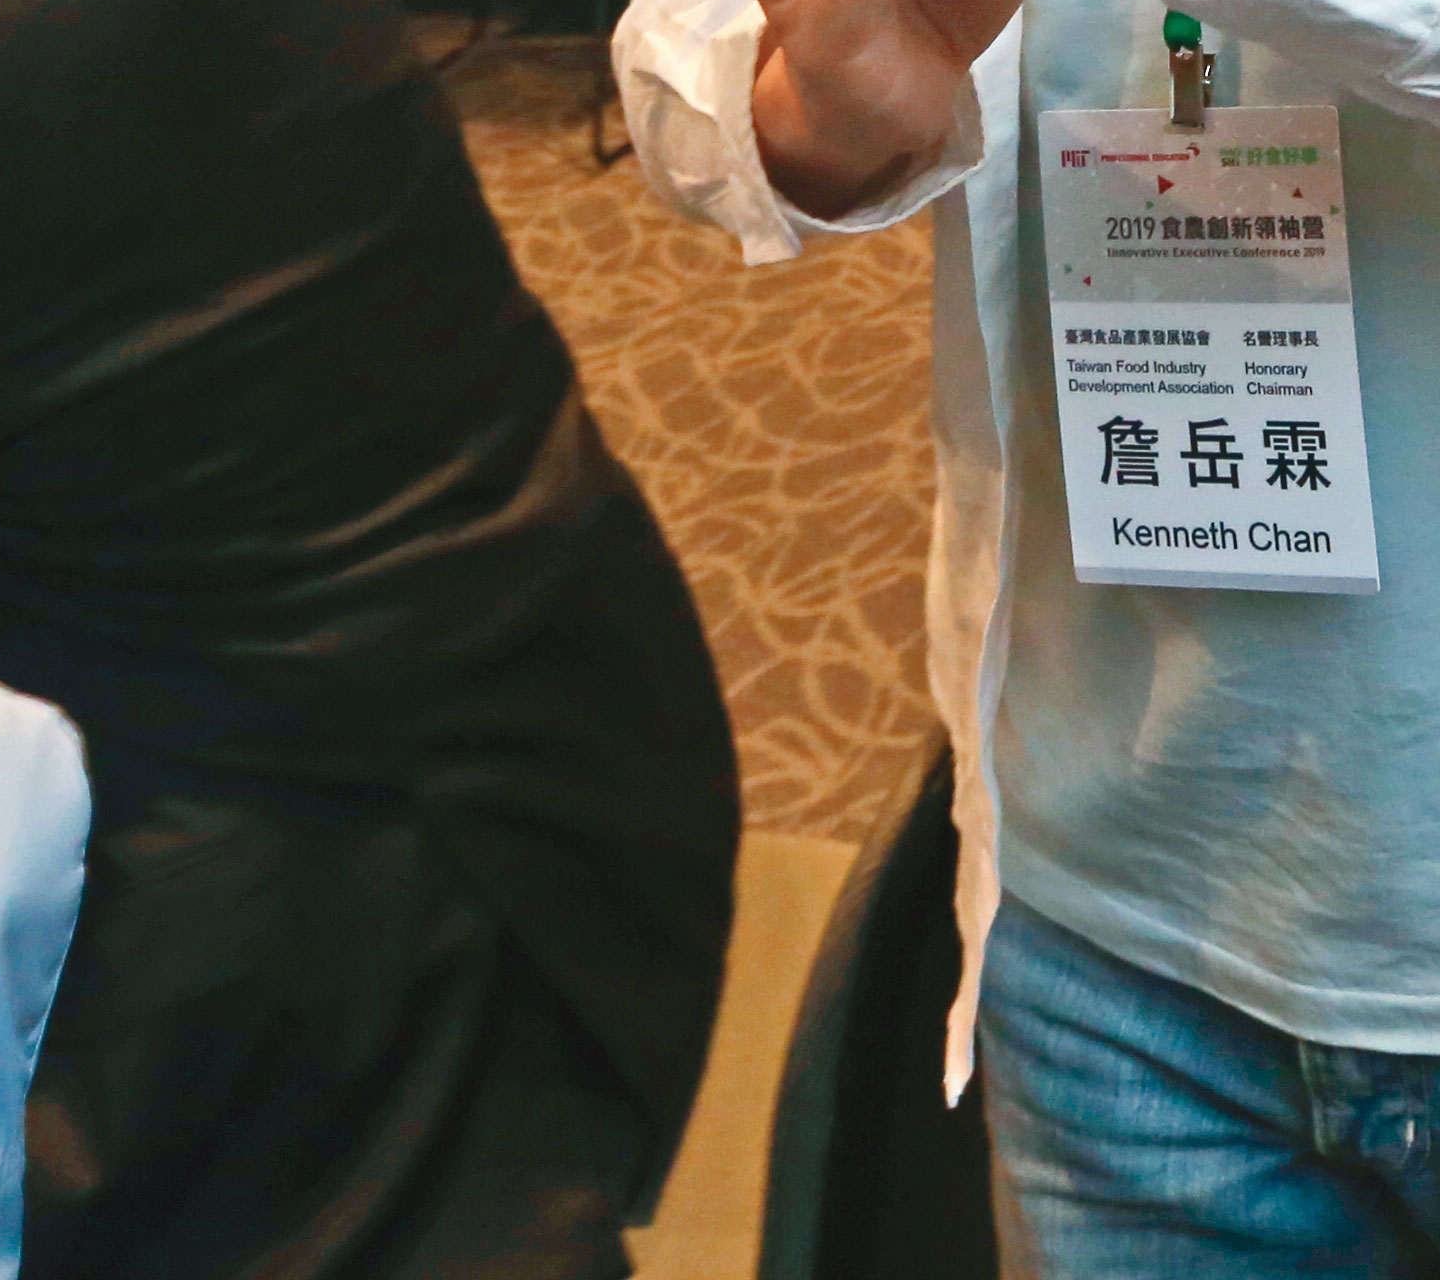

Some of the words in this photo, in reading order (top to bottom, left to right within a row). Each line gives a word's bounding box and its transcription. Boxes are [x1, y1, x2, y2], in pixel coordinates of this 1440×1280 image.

[1106, 217, 1156, 240] 2019
[1106, 247, 1169, 258] Innovative
[1172, 247, 1230, 258] Executive
[1232, 247, 1301, 258] Conference
[1303, 247, 1326, 258] 2019
[1064, 329, 1210, 347] 臺灣食品產業發展協會
[1066, 358, 1112, 374] Taiwan
[1115, 359, 1149, 374] Food
[1153, 360, 1207, 378] Industry
[1244, 361, 1308, 379] Honorary
[1068, 378, 1155, 396] Development
[1157, 380, 1235, 396] Association
[1246, 381, 1314, 396] Chairman
[1097, 415, 1332, 491] 詹岳霖
[1112, 516, 1238, 550] Kenneth
[1248, 521, 1332, 553] Chan
